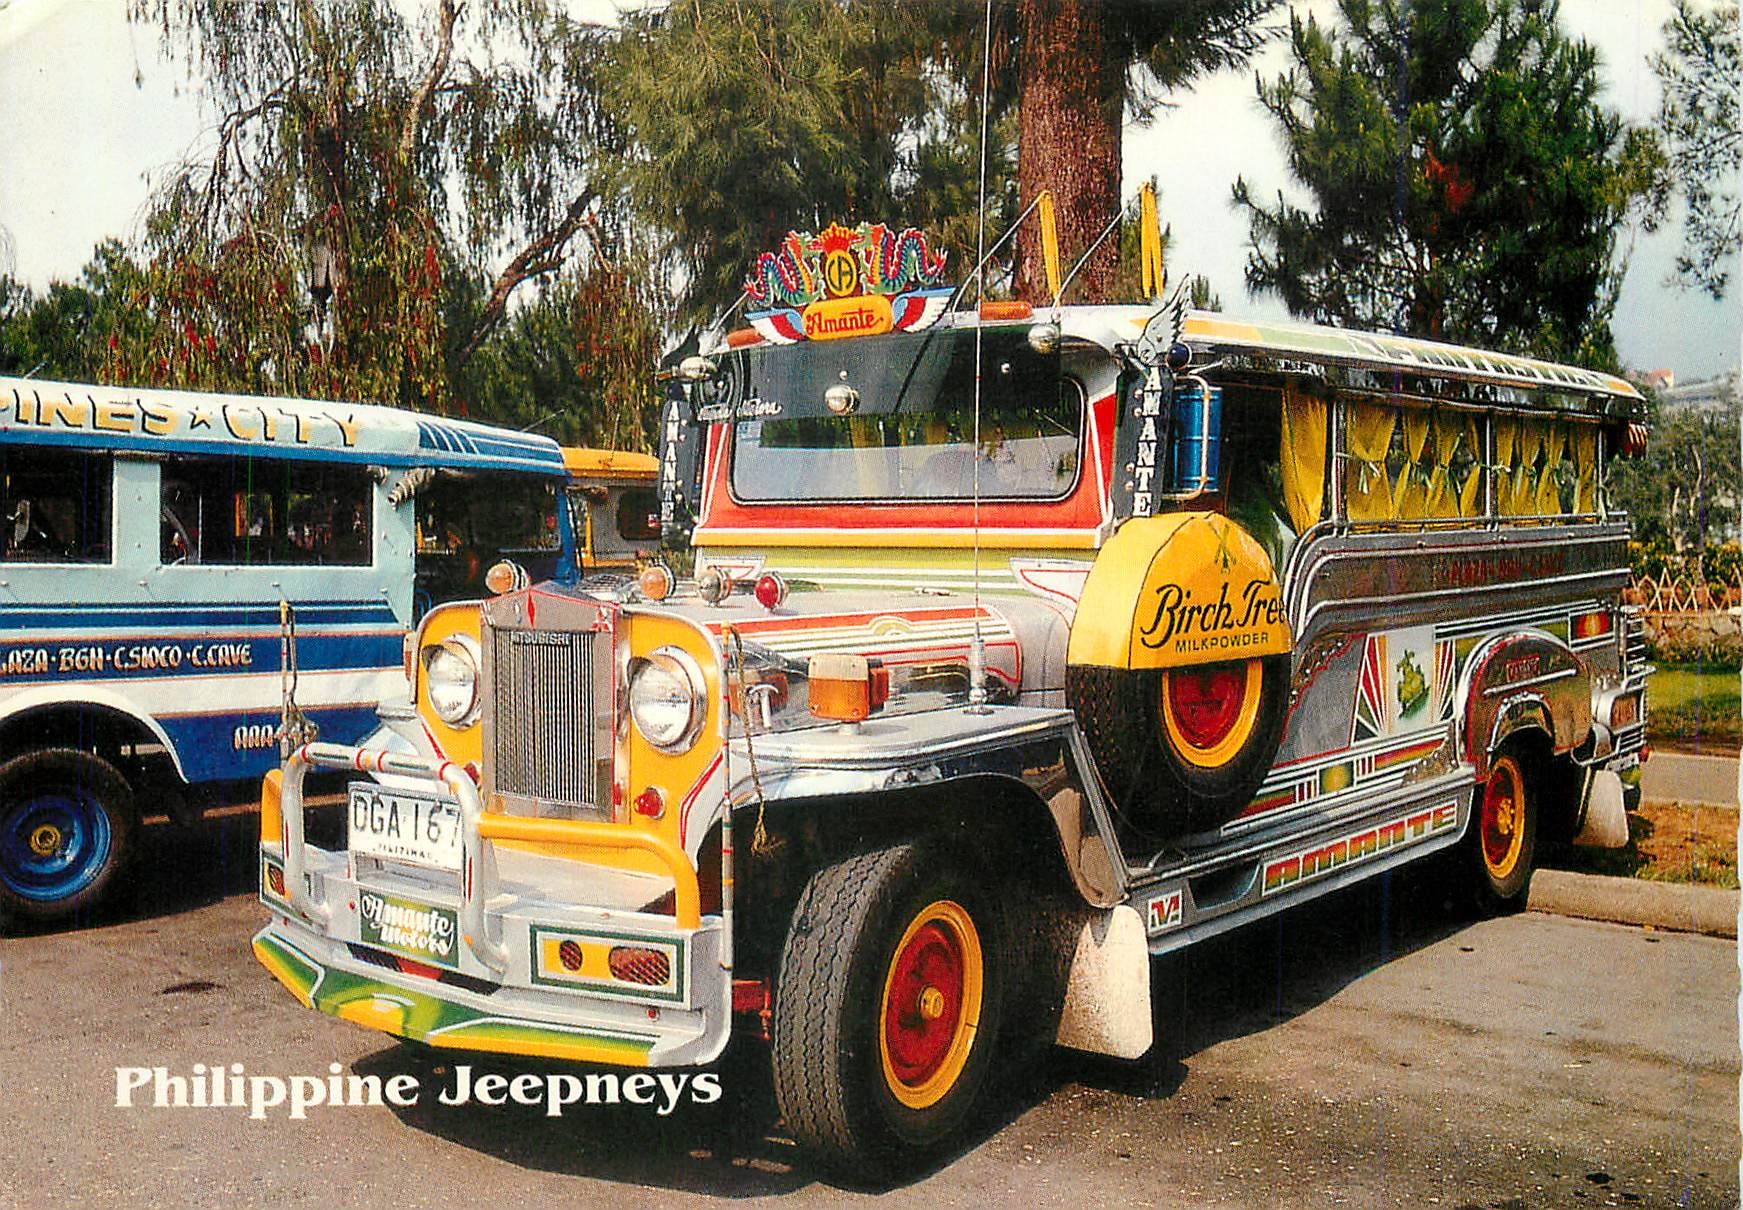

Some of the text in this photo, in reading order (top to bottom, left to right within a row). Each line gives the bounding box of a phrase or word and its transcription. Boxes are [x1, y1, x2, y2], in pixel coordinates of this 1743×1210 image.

[221, 403, 357, 447] CITY
[1132, 366, 1163, 517] AMANTE
[660, 401, 680, 523] AMANTE
[1140, 580, 1285, 649] Birch Tree
[1175, 632, 1269, 653] MILKPOWDER
[353, 796, 461, 848] DGA 167
[361, 894, 454, 936] Amante
